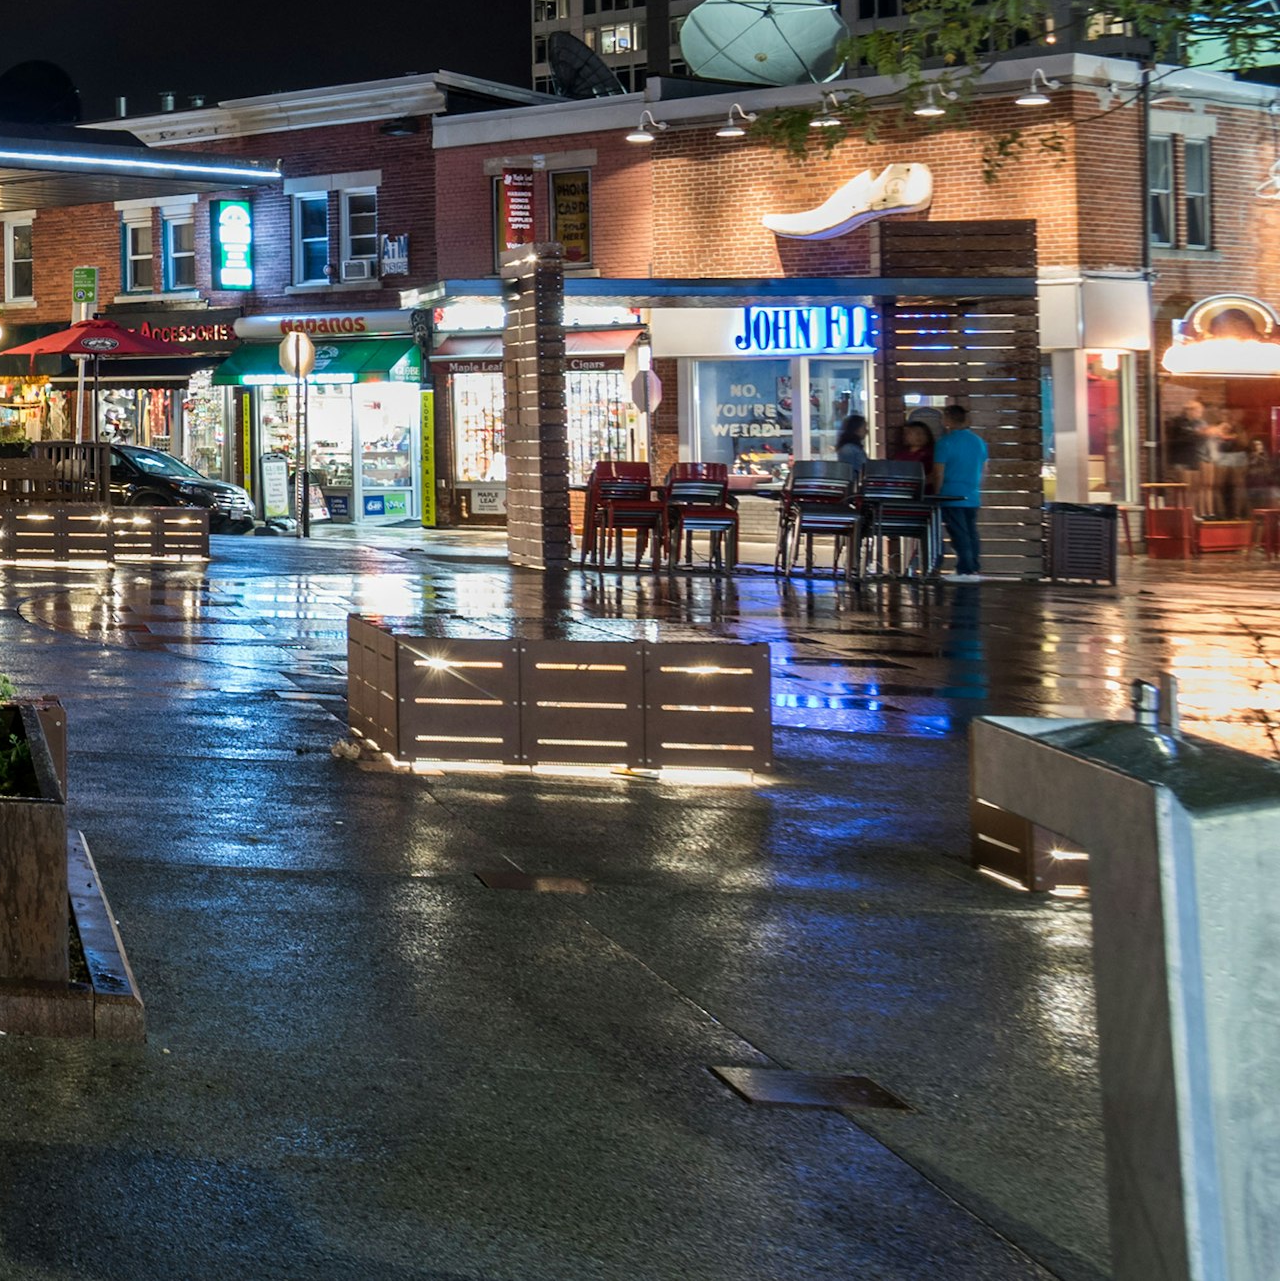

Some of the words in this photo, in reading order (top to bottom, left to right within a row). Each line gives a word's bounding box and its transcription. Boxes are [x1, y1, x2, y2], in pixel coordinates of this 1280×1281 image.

[140, 321, 237, 344] ACCESSORIES
[734, 307, 812, 351] JOHN
[449, 362, 479, 373] Maple
[570, 359, 605, 372] Cigars
[424, 481, 432, 523] CIGARS
